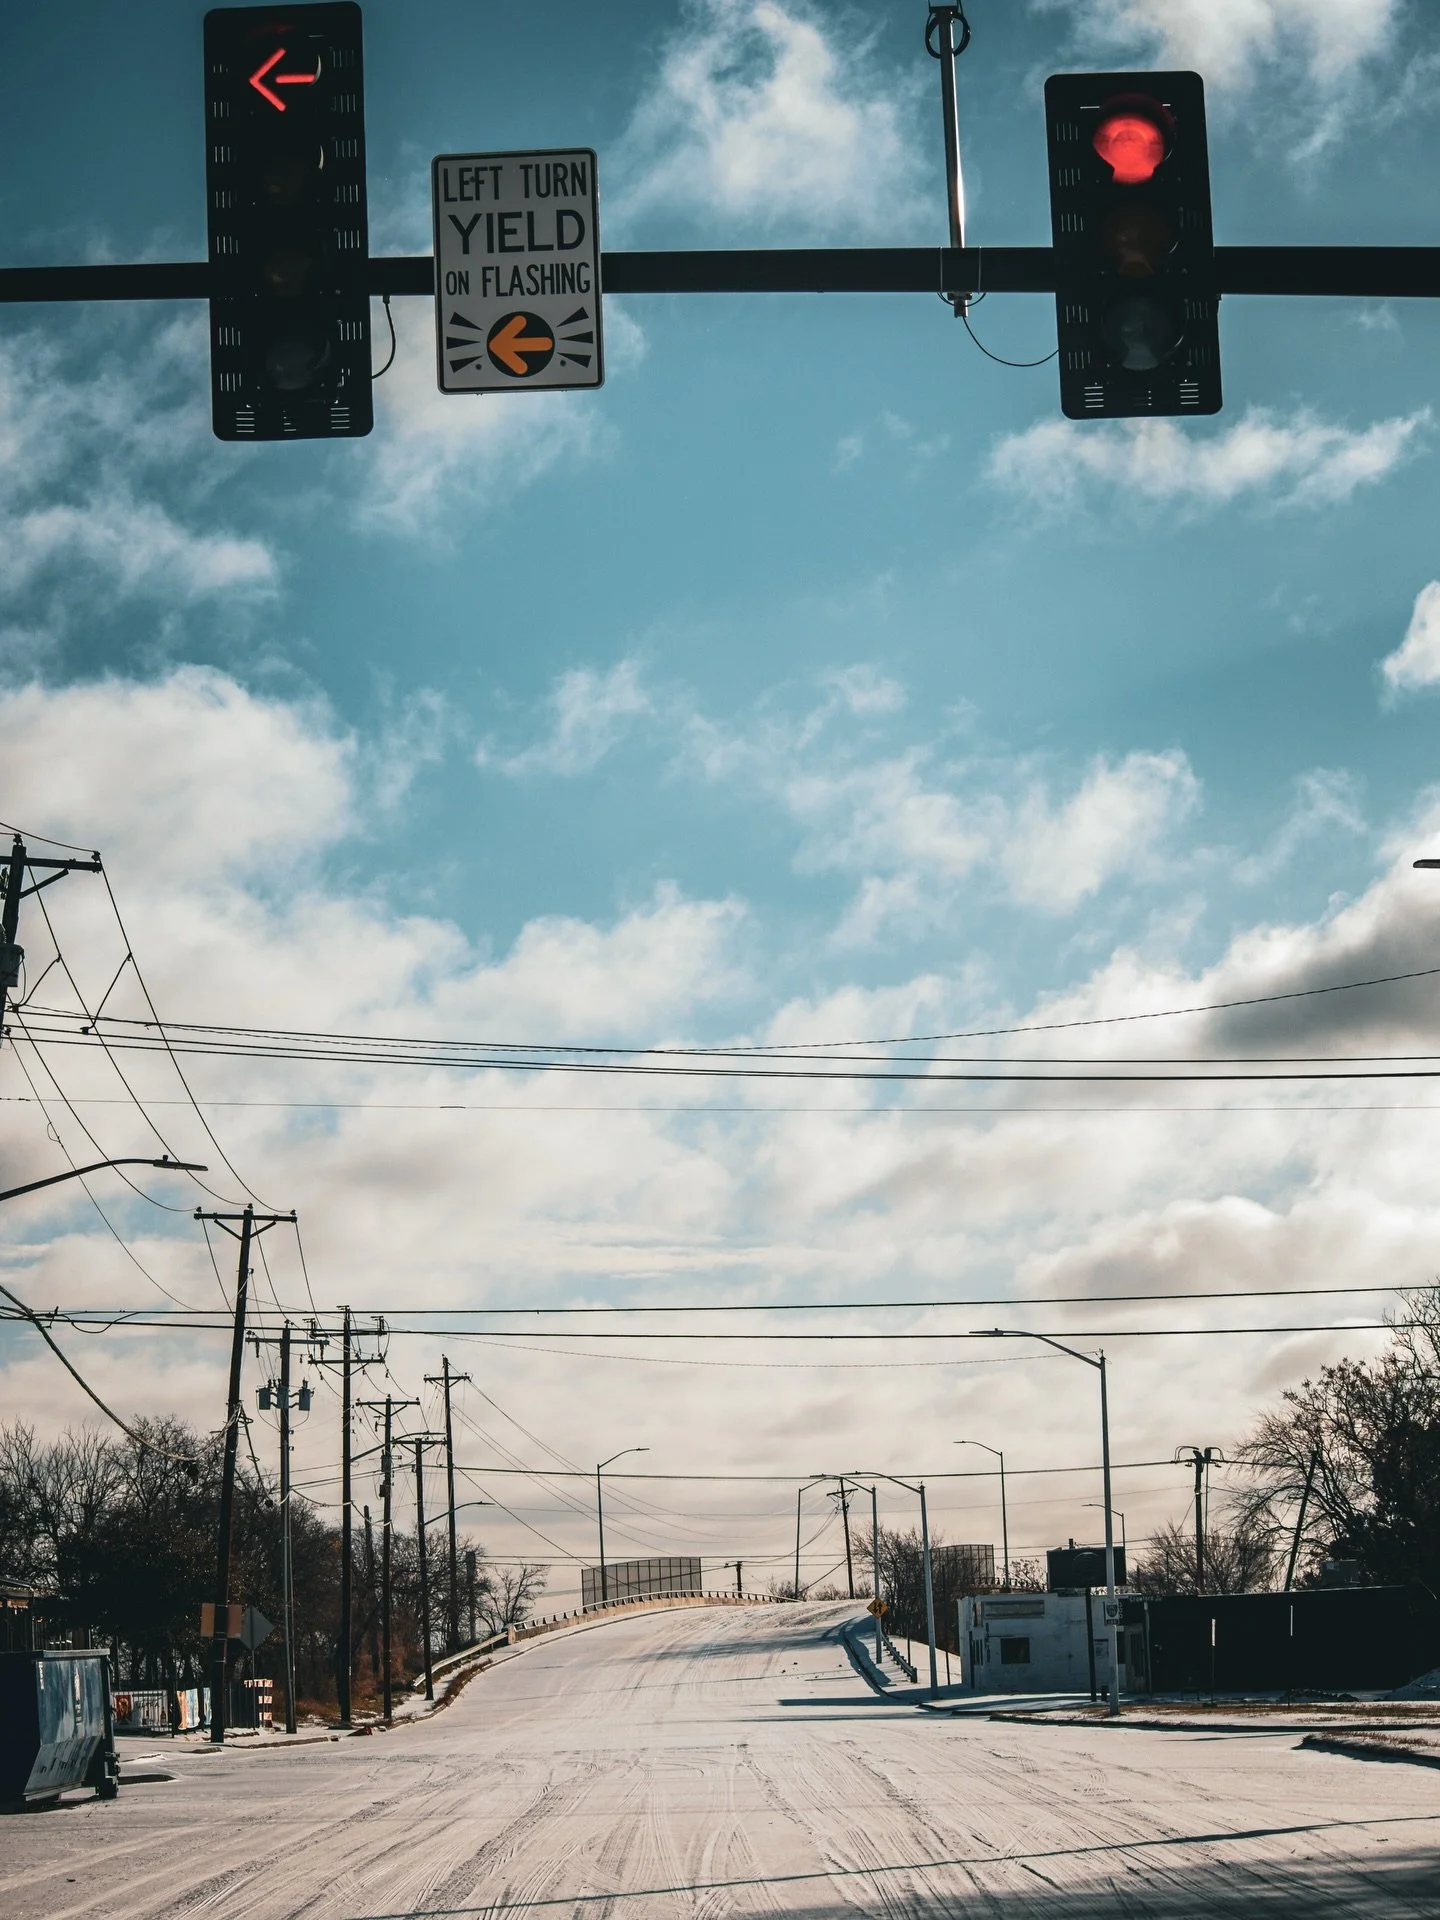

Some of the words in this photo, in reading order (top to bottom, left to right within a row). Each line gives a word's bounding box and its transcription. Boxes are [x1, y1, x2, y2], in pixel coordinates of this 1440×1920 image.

[443, 165, 503, 203] LEFT
[519, 161, 587, 199] TURN
[447, 209, 586, 255] YIELD
[445, 270, 470, 296] ON
[481, 262, 591, 298] FLASHING
